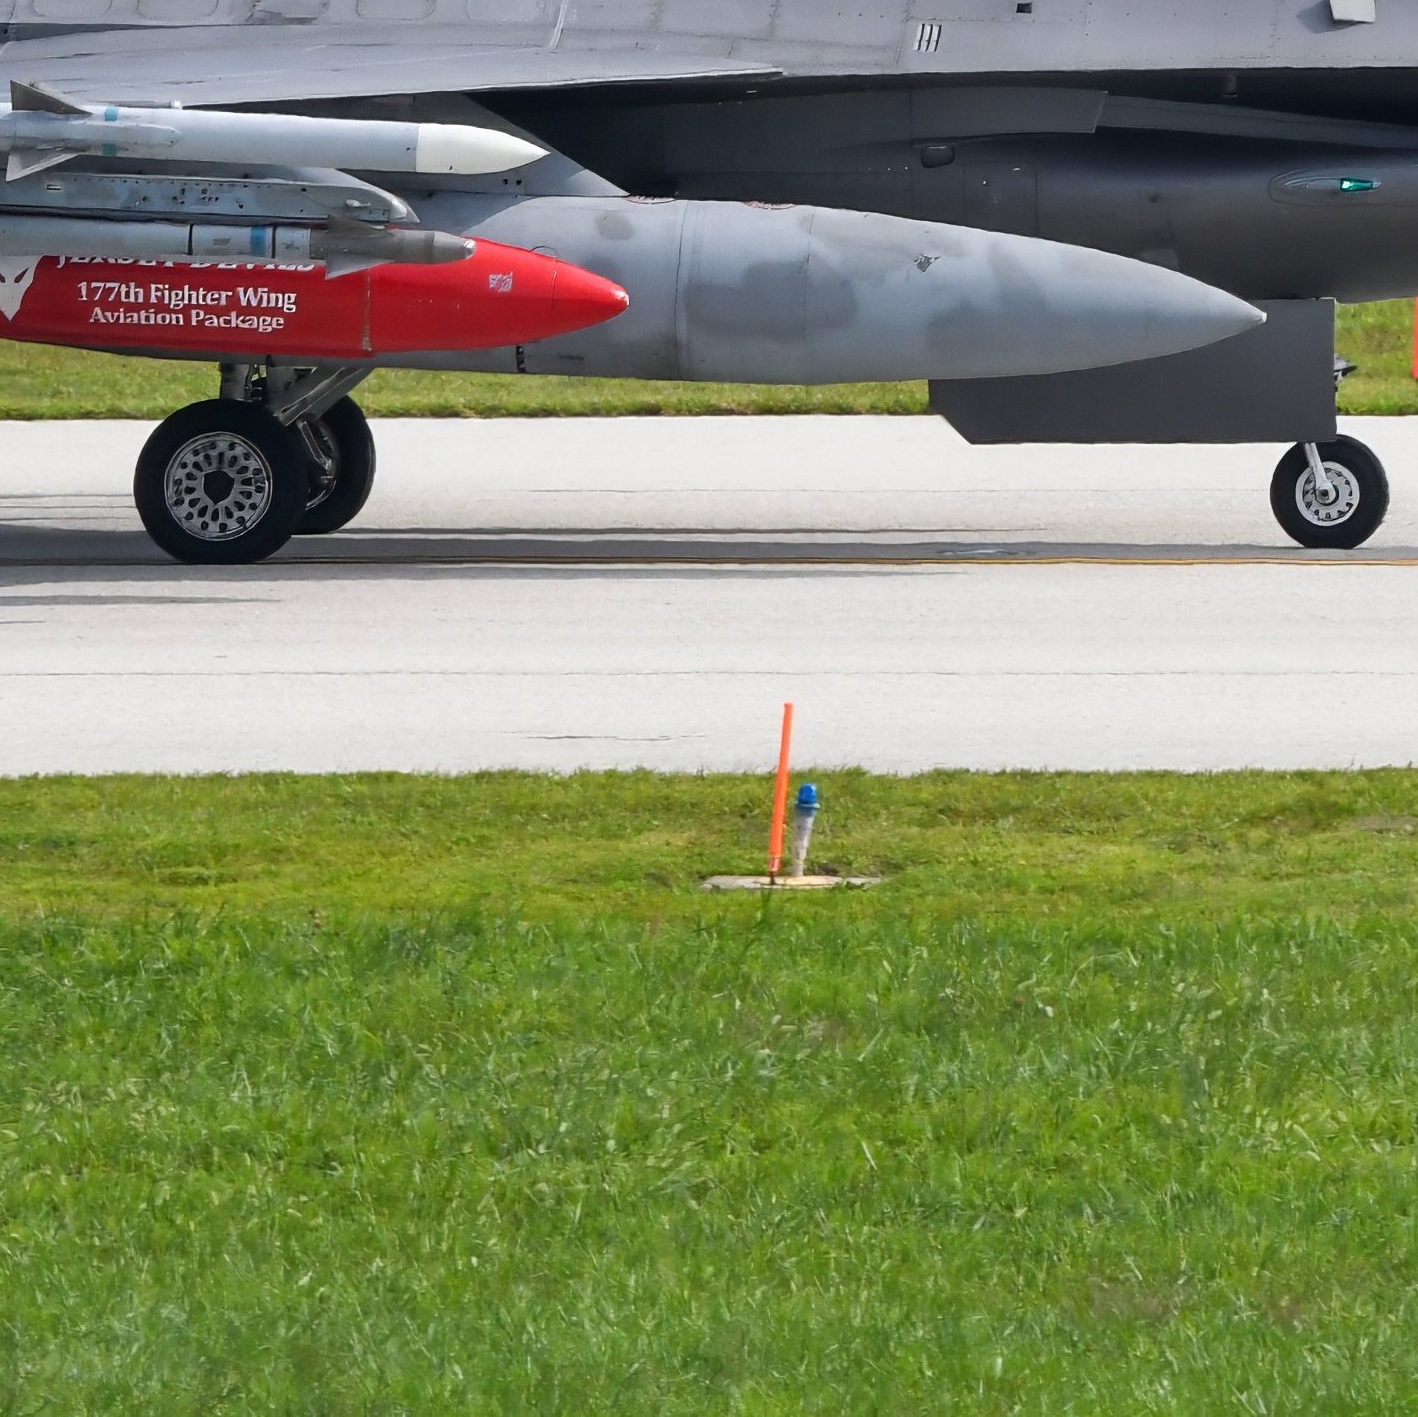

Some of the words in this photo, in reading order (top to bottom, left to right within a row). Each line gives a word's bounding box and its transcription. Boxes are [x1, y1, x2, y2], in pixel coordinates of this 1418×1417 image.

[77, 281, 143, 304] 177th
[149, 283, 233, 310] Fighter
[236, 286, 297, 313] Wing
[89, 306, 184, 326] Aviation
[190, 309, 285, 333] Package
